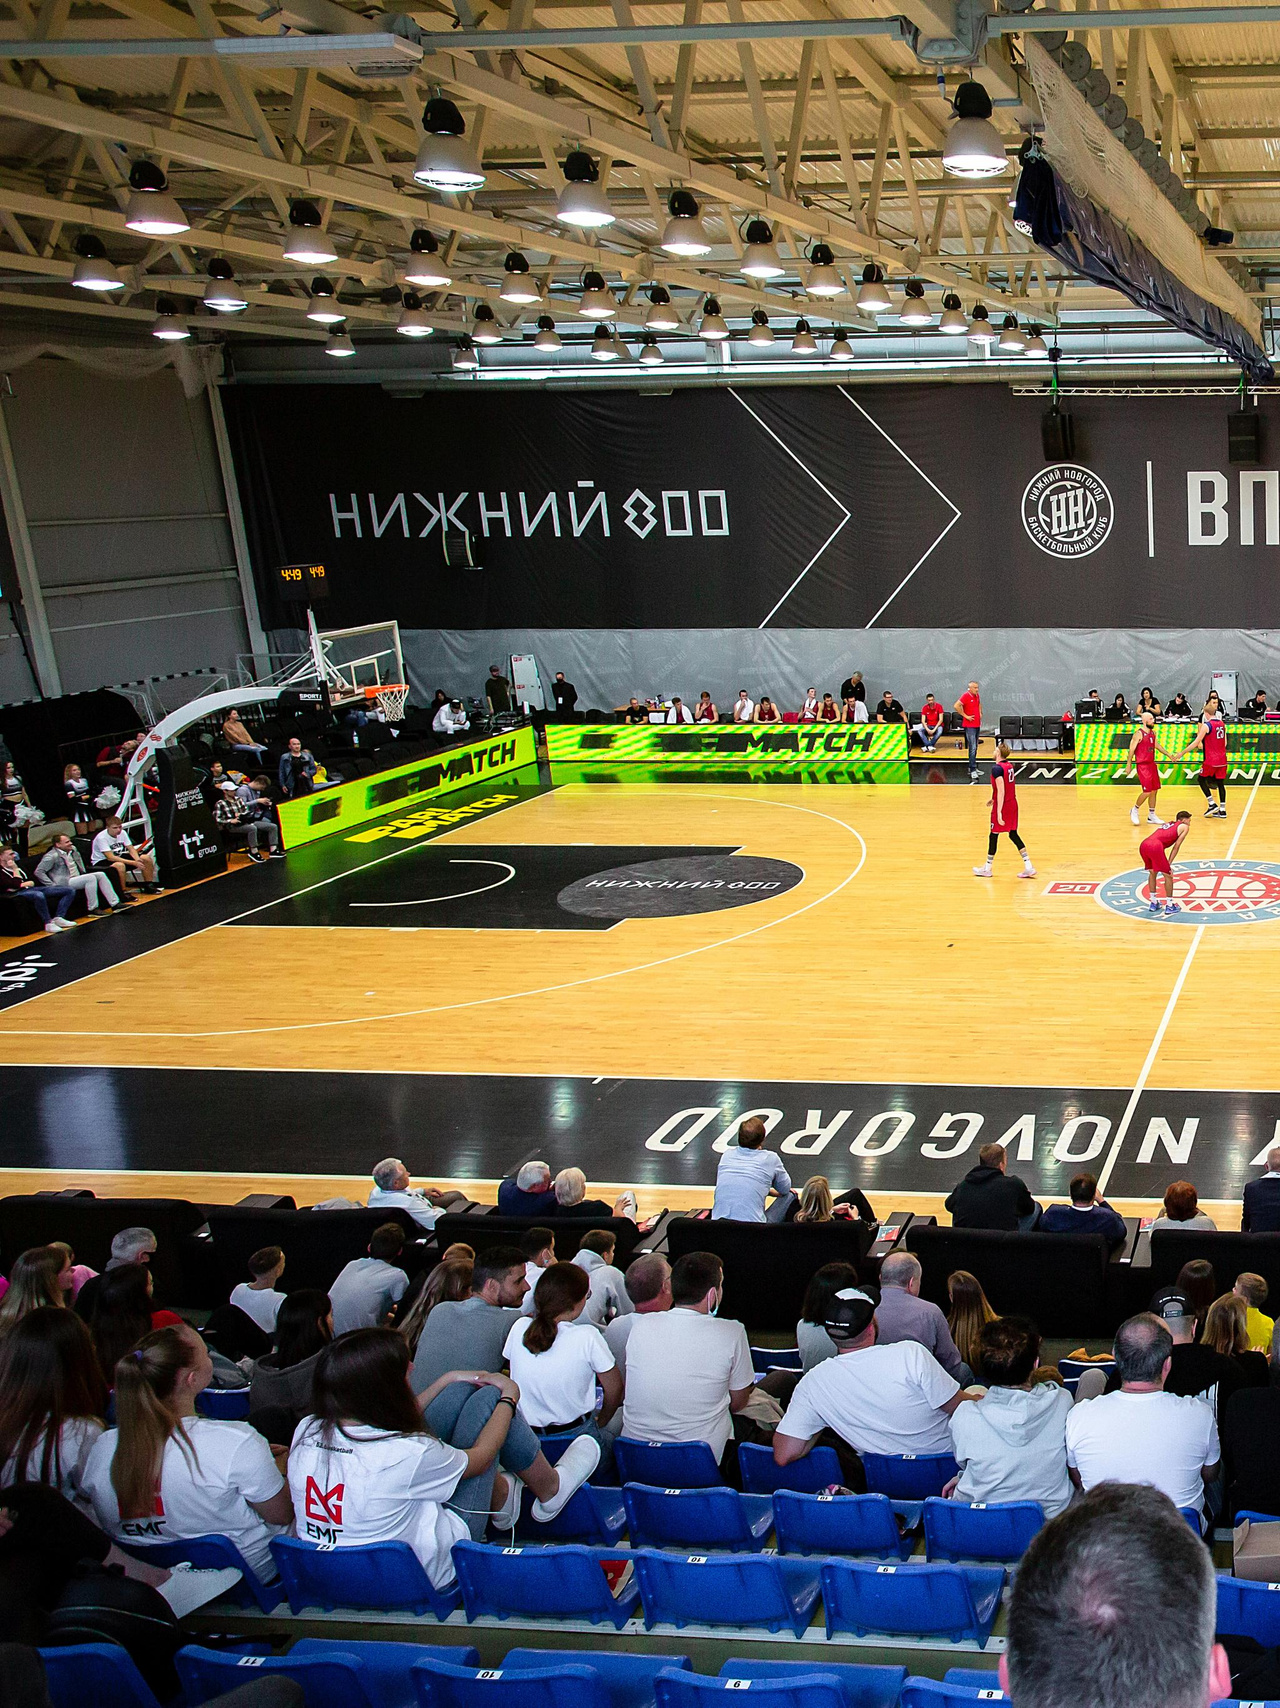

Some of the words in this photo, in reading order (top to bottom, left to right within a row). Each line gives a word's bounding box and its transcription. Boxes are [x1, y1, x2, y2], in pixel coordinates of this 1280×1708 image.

[1028, 468, 1062, 501] НИЖНИЙ
[1064, 469, 1106, 502] НОВГОРОД
[329, 480, 611, 538] НИЖНИЙ
[622, 488, 730, 540] 800
[1027, 516, 1095, 553] БАСКЕТБОЛЬНЫЙ
[1092, 515, 1108, 540] КЛУБ
[746, 732, 875, 752] MATCH
[344, 807, 452, 843] PARI
[389, 794, 519, 839] MATCH
[198, 845, 218, 858] group
[585, 879, 727, 889] НИЖНИЙ
[1056, 884, 1090, 894] 20
